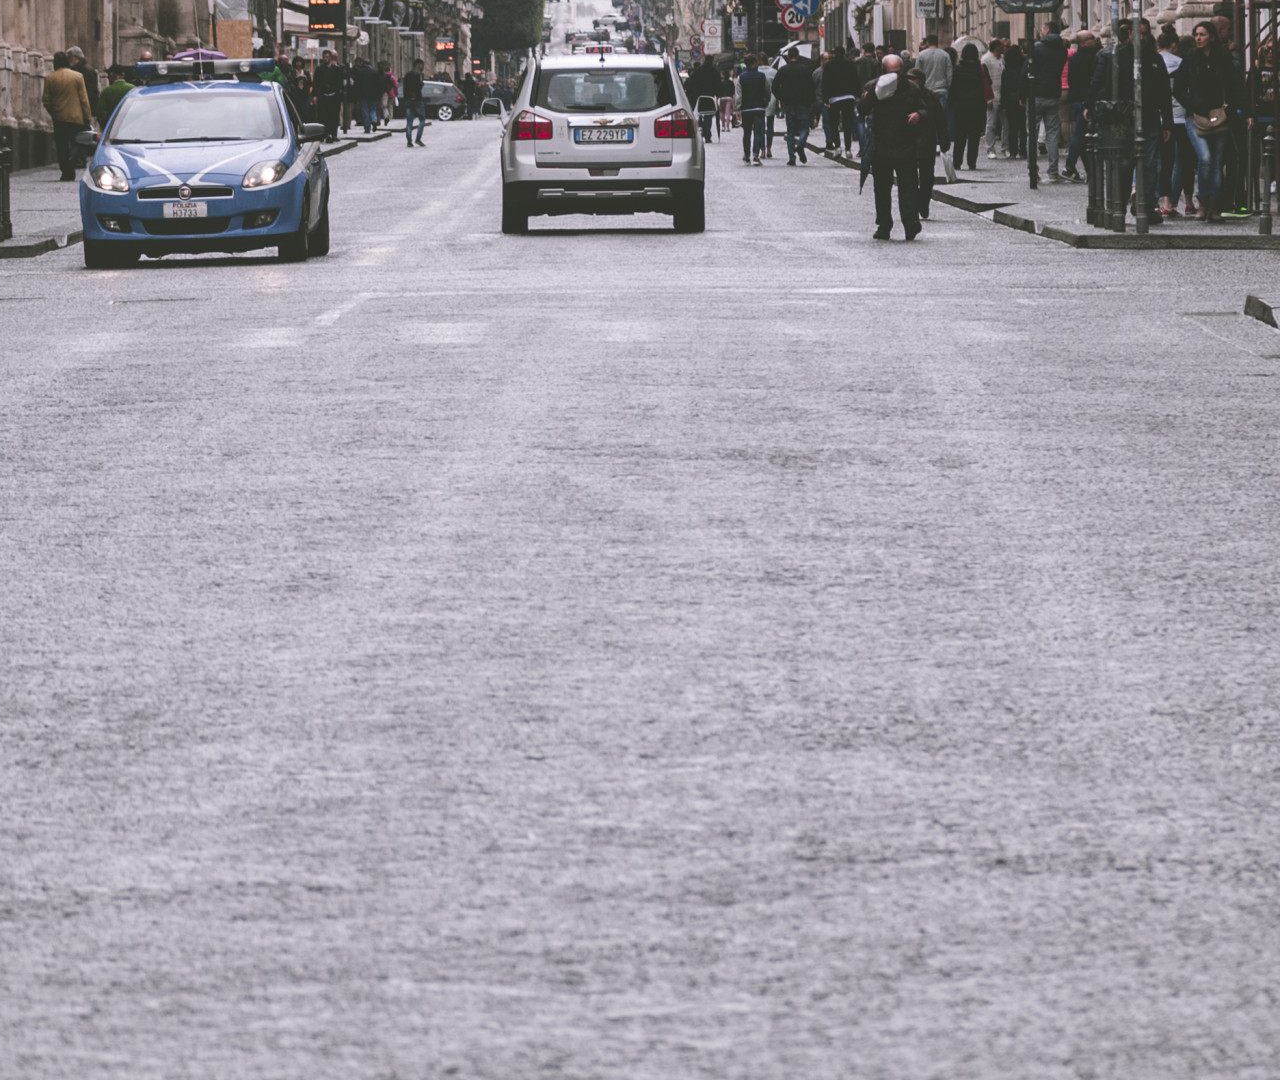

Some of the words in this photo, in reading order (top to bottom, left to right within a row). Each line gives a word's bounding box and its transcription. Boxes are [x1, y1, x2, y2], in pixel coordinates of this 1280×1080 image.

[788, 10, 803, 24] 20
[581, 130, 593, 141] EZ
[596, 129, 626, 141] 229YP
[172, 209, 198, 217] H3733
